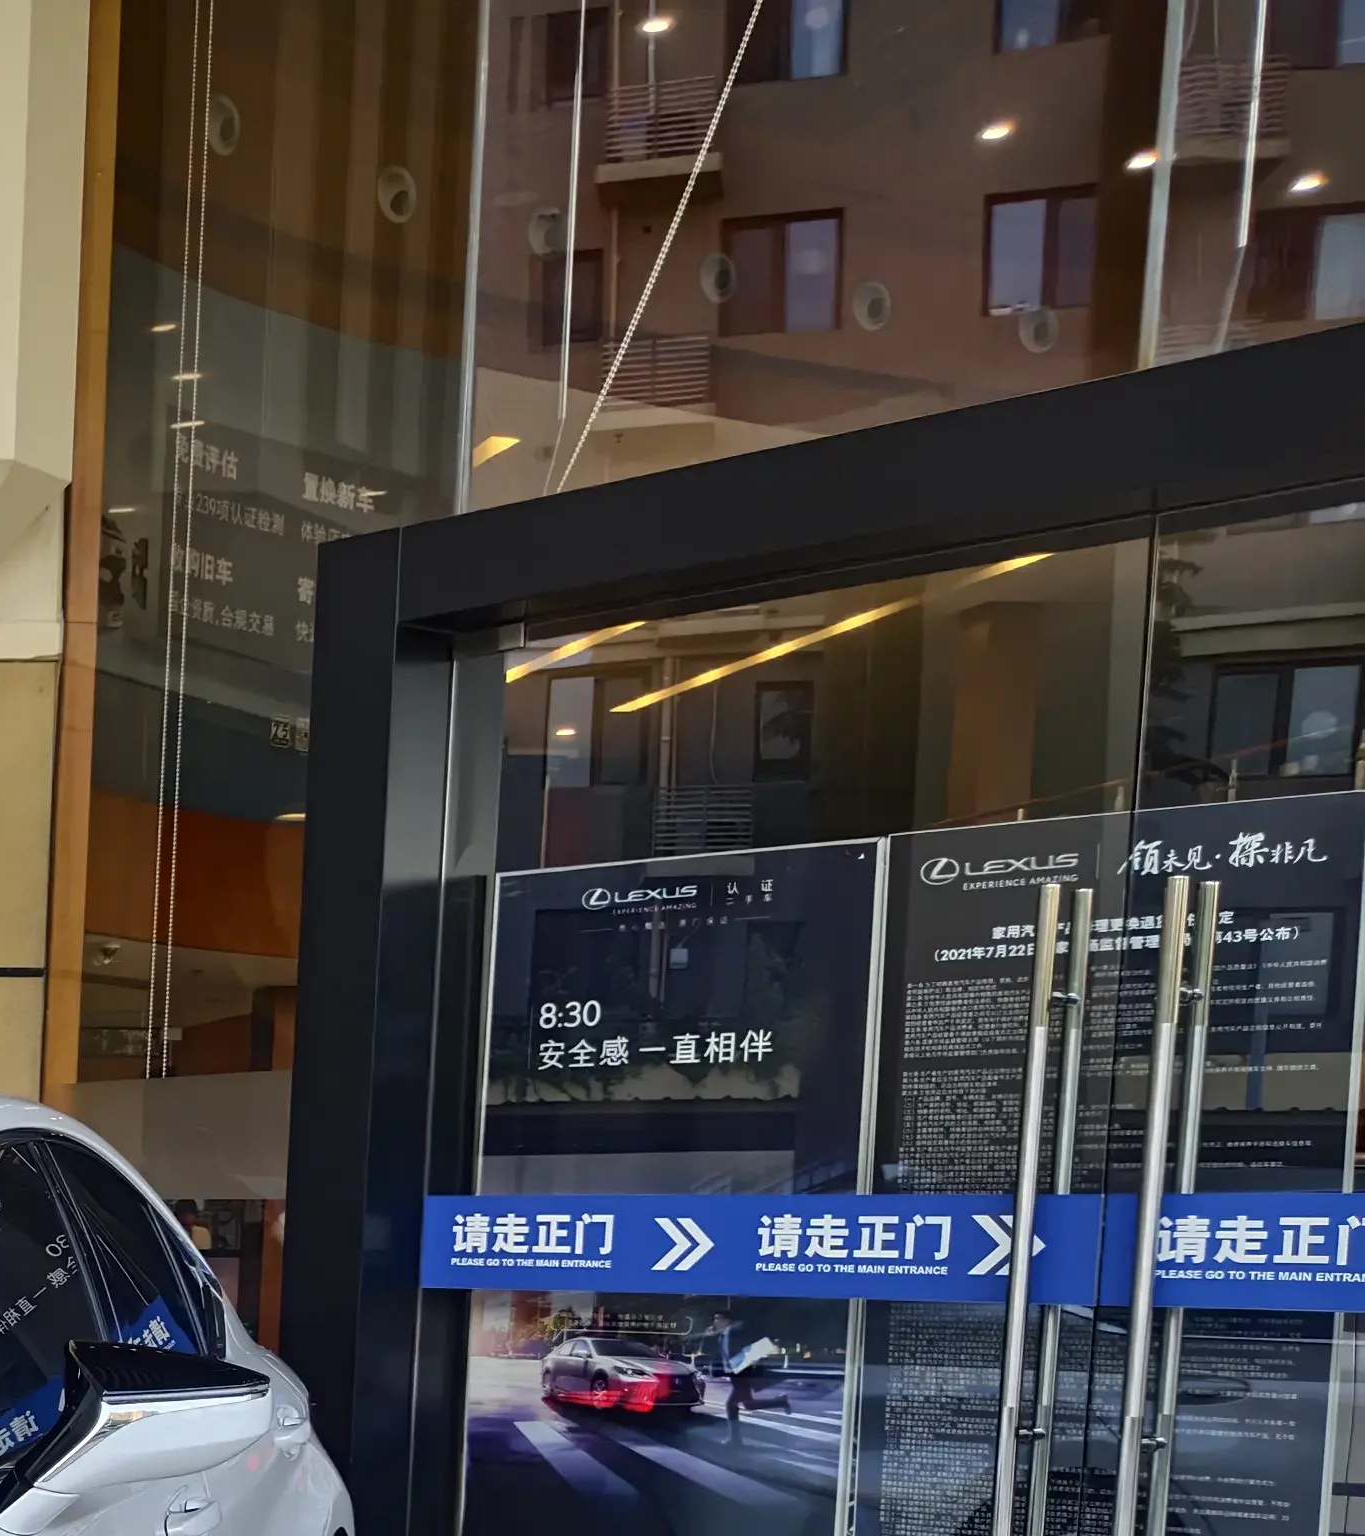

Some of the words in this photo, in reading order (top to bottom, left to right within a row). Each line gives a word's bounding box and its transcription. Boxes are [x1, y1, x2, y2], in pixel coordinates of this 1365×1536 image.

[965, 853, 1079, 876] LEXUS
[962, 877, 1026, 891] EXPERIENCE
[1029, 874, 1079, 886] AMAZING
[615, 885, 698, 904] LEXUS
[539, 1000, 602, 1029] 8:30
[538, 1035, 630, 1071] 安全感
[638, 1028, 773, 1065] 一直相伴
[452, 1212, 615, 1256] 请走正门
[757, 1213, 952, 1261] 请走正门
[451, 1257, 484, 1266] PLEASE
[486, 1258, 500, 1267] GO
[502, 1258, 514, 1267] TO
[517, 1259, 534, 1267] THE
[536, 1259, 559, 1268] MAIN
[561, 1260, 612, 1269] ENTRANCE
[755, 1262, 795, 1272] PLEASE
[798, 1263, 814, 1273] GO
[817, 1263, 831, 1273] TO
[833, 1264, 855, 1274] THE
[857, 1265, 885, 1274] MAIN
[887, 1265, 949, 1275] ENTRANCE
[1154, 1269, 1203, 1280] PLEASE
[1204, 1270, 1225, 1280] GO
[1227, 1270, 1246, 1281] TO
[1249, 1271, 1275, 1281] THE
[1278, 1272, 1312, 1282] MAIN
[1316, 1272, 1365, 1283] ENTRA
